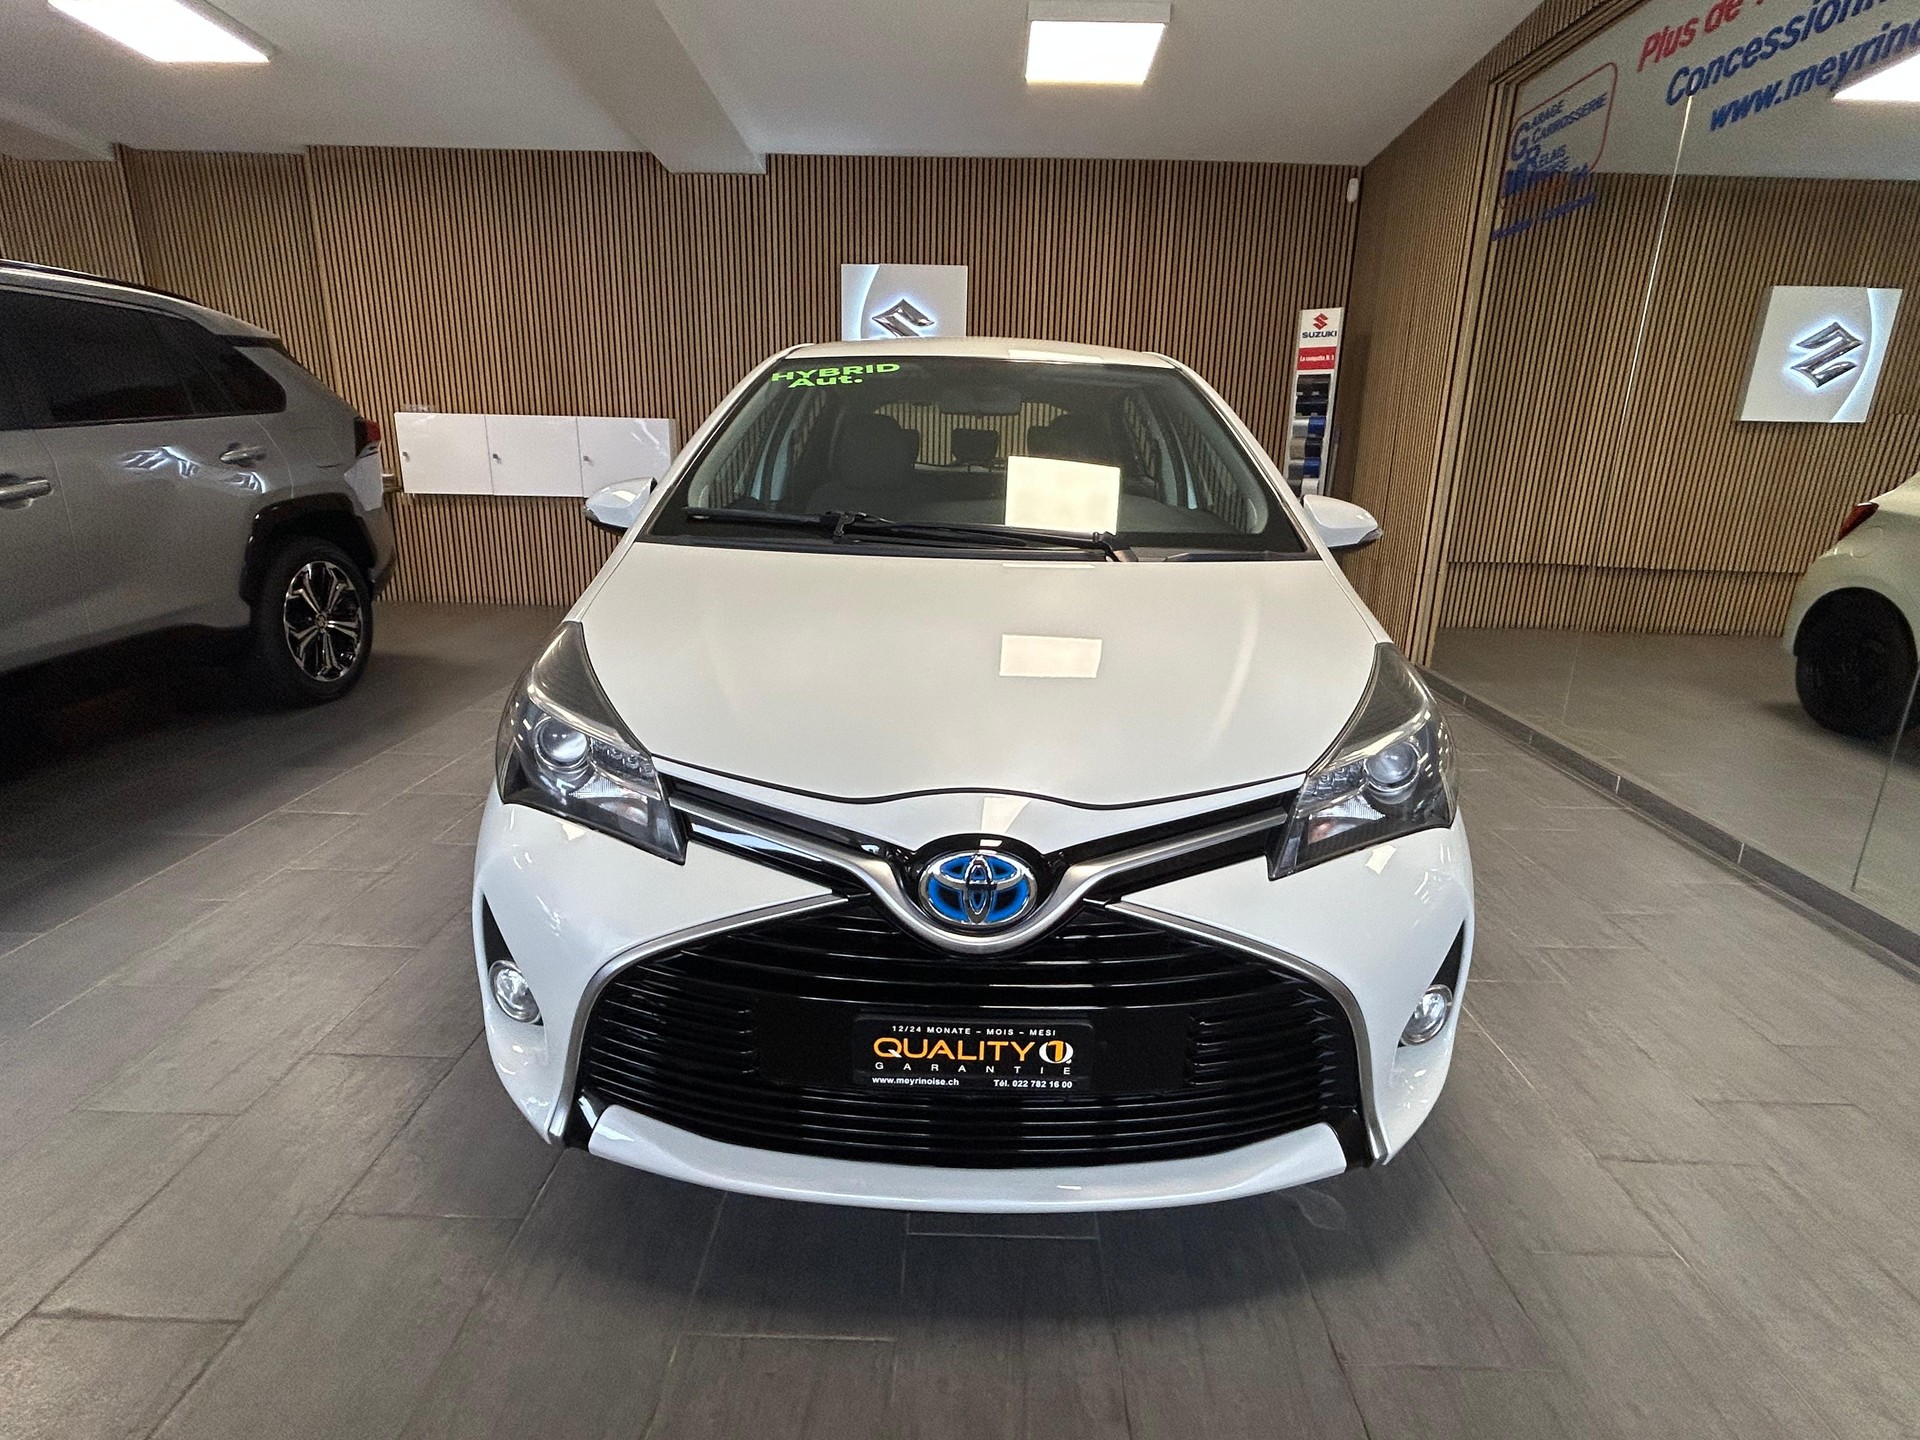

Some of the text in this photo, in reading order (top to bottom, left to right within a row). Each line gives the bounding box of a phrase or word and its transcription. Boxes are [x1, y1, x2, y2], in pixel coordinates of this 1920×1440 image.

[1637, 17, 1699, 73] Plus
[771, 363, 901, 382] HYBRID
[788, 375, 863, 389] Aut.
[892, 1025, 922, 1033] 12/24
[927, 1026, 971, 1035] MONATE
[986, 1028, 1014, 1036] MOIS
[1029, 1029, 1056, 1037] MESI
[875, 1062, 1071, 1075] GARANTIE
[872, 1076, 960, 1086] www.meyrinoise.ch
[994, 1079, 1010, 1087] Tél.
[1012, 1080, 1028, 1088] 022
[1031, 1080, 1047, 1088] 782
[1049, 1080, 1060, 1088] 16
